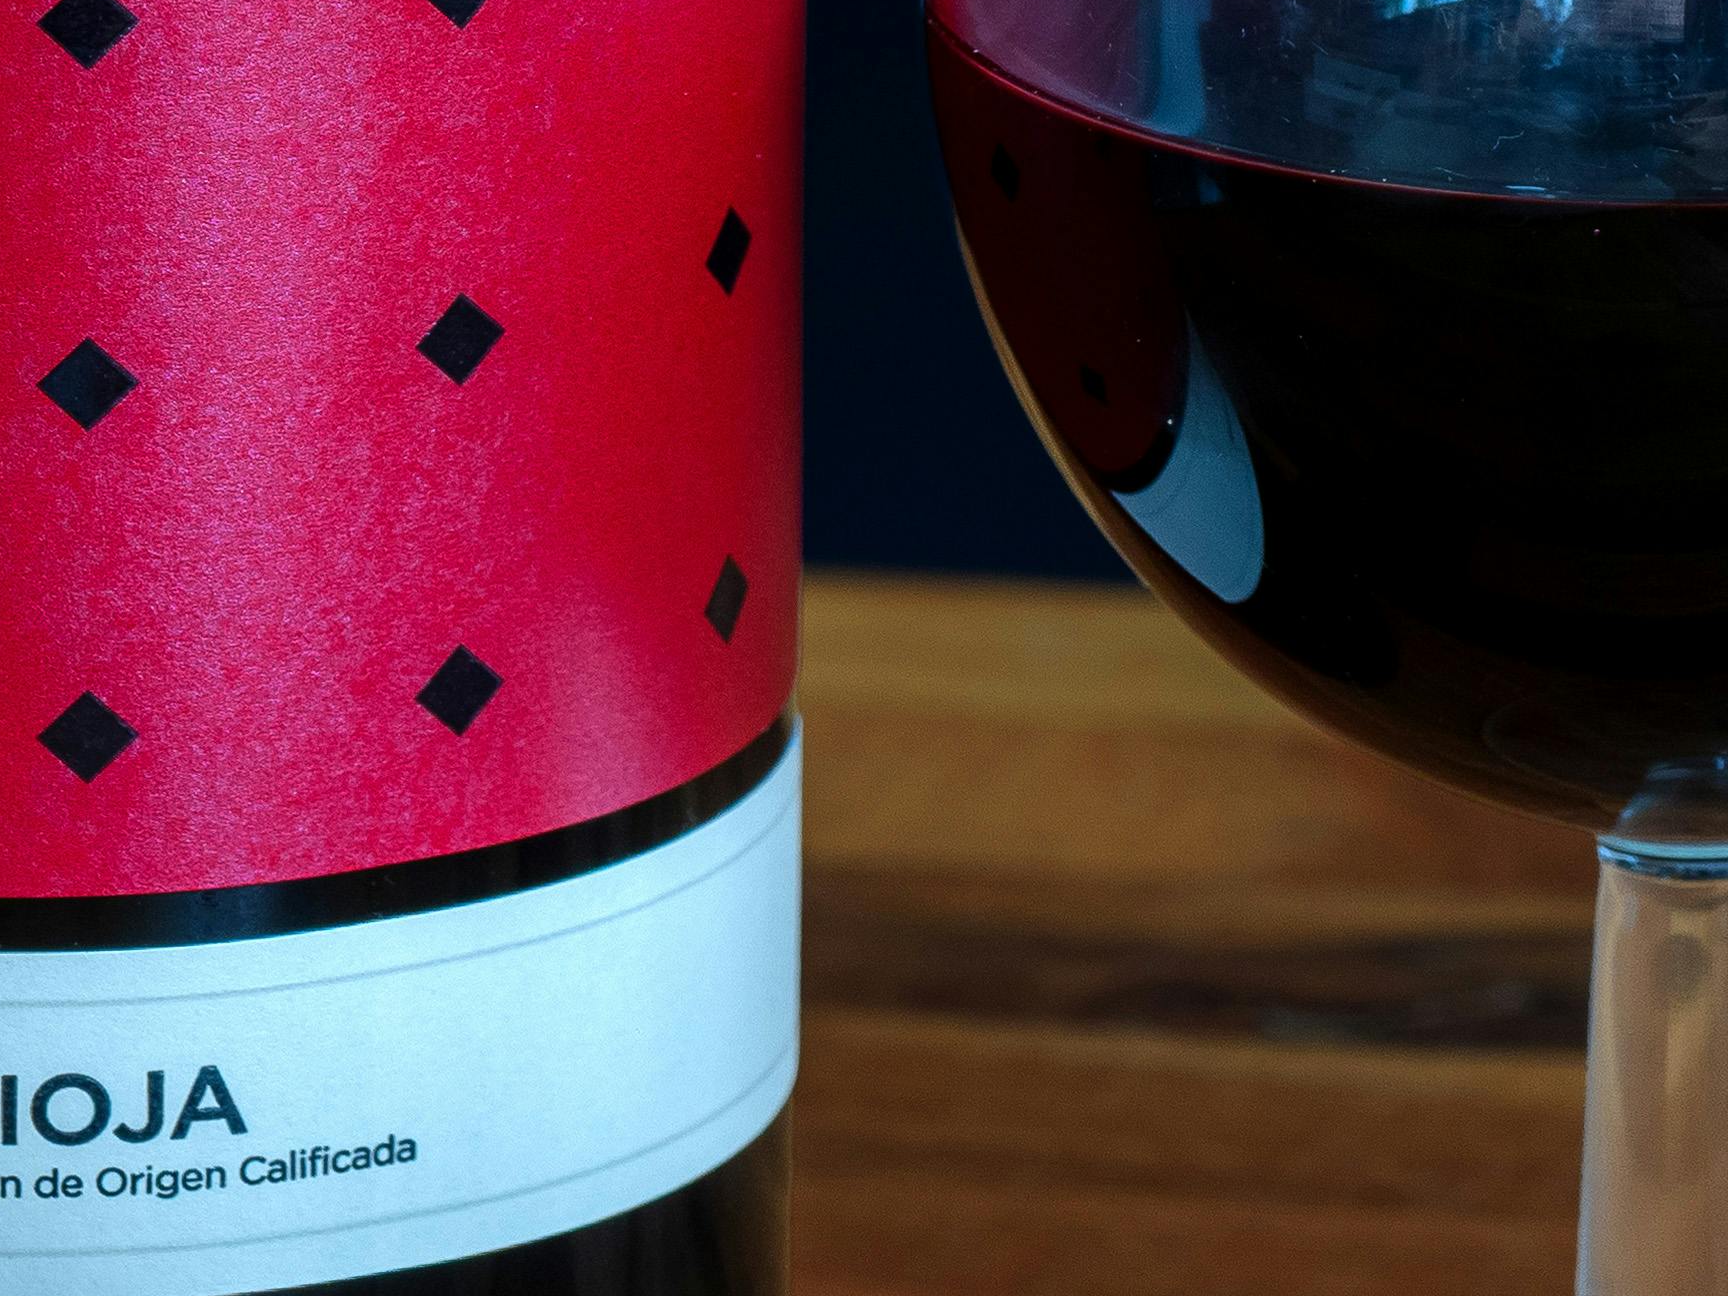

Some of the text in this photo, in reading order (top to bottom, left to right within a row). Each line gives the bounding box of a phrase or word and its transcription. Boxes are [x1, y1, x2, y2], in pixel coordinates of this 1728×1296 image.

[34, 1167, 83, 1199] de
[96, 1164, 227, 1201] Origen
[239, 1134, 418, 1187] Calificada
